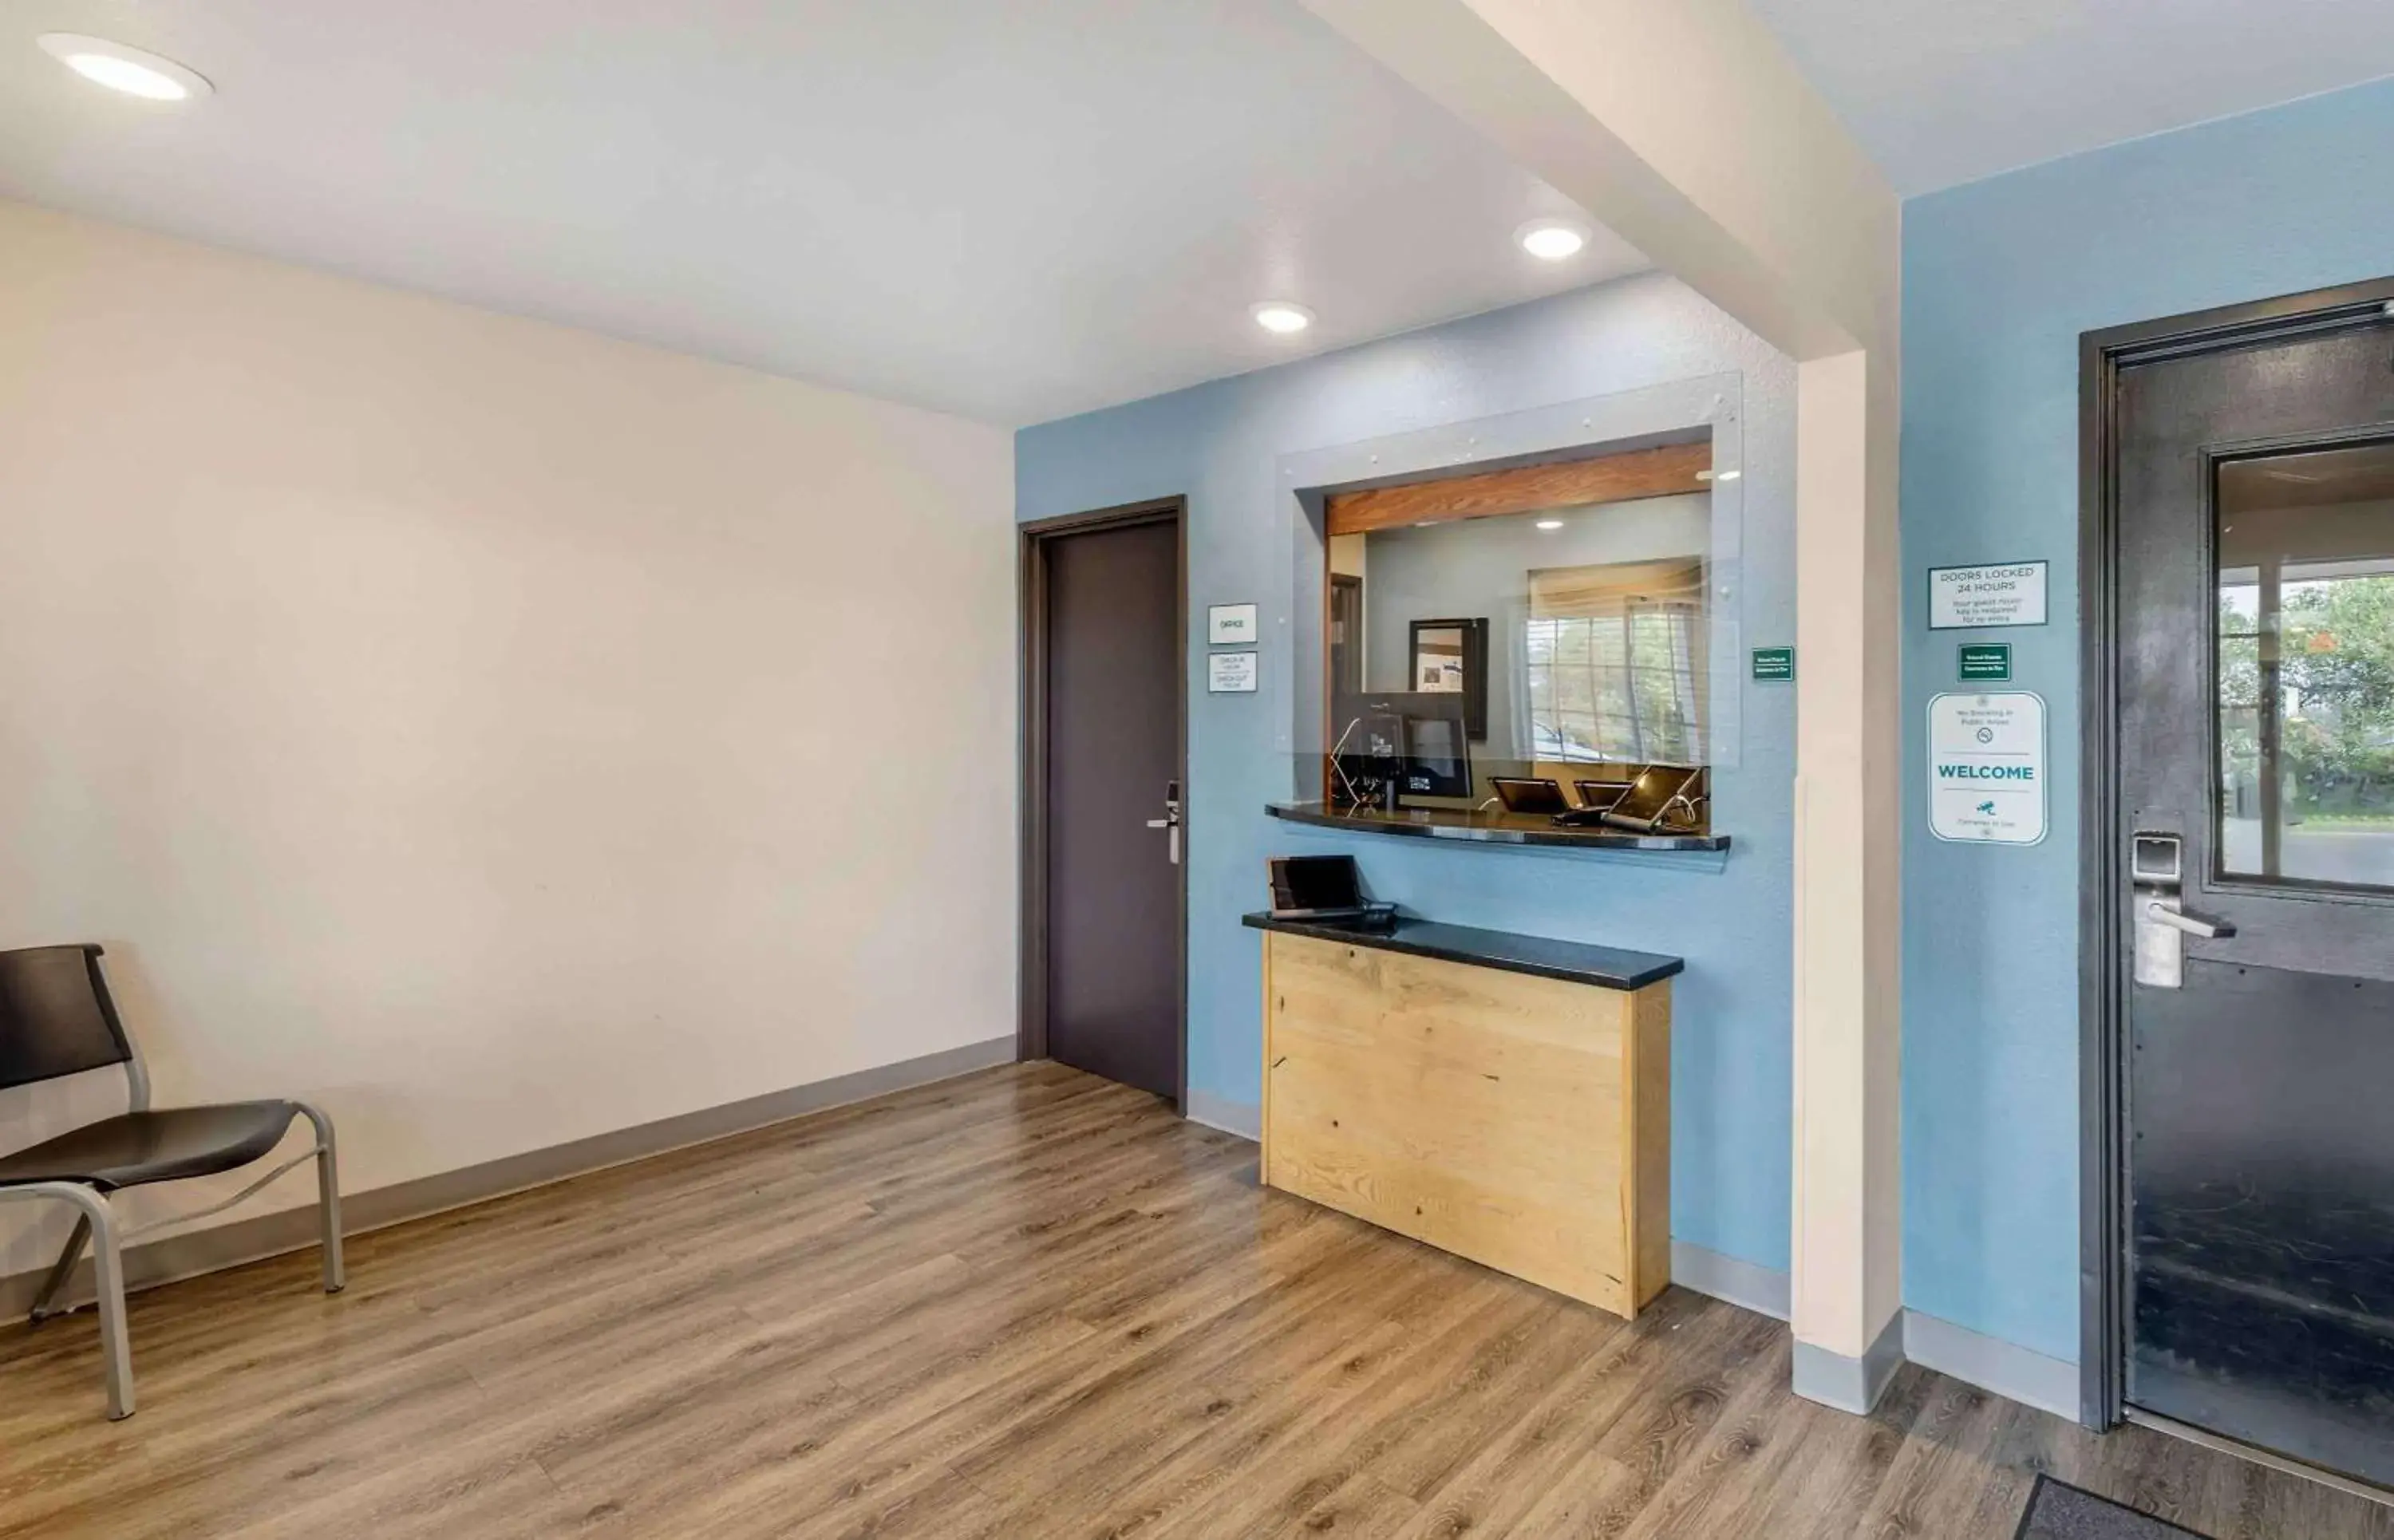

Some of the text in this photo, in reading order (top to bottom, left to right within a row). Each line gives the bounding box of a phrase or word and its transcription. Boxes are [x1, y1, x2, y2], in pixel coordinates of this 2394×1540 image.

[1941, 567, 2034, 582] DOORS LOCKED
[1957, 581, 2016, 593] 24 HOURS
[1938, 765, 2034, 780] WELCOME
